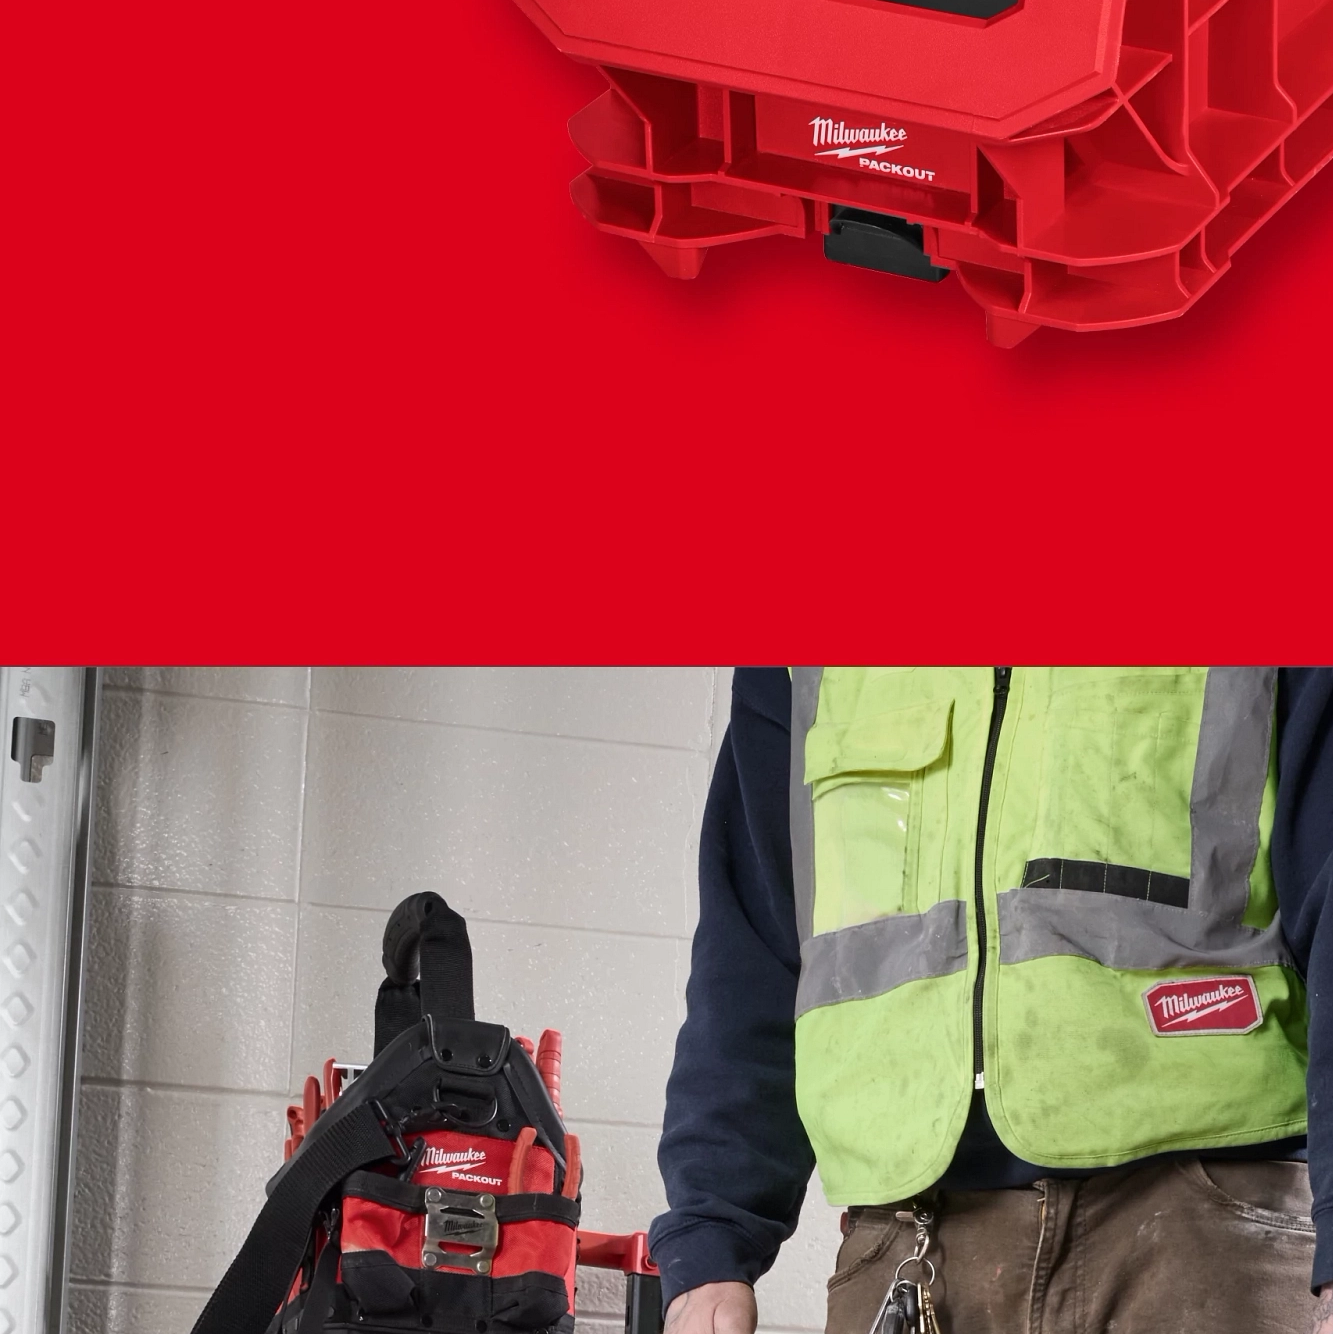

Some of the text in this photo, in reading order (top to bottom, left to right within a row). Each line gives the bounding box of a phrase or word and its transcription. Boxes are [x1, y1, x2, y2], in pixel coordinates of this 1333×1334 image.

[808, 116, 908, 147] Milwaukee
[859, 157, 936, 182] PACKOUT
[1154, 984, 1245, 1019] Milwaukee
[420, 1147, 487, 1167] Milwaukee
[451, 1171, 503, 1186] PACKOUT
